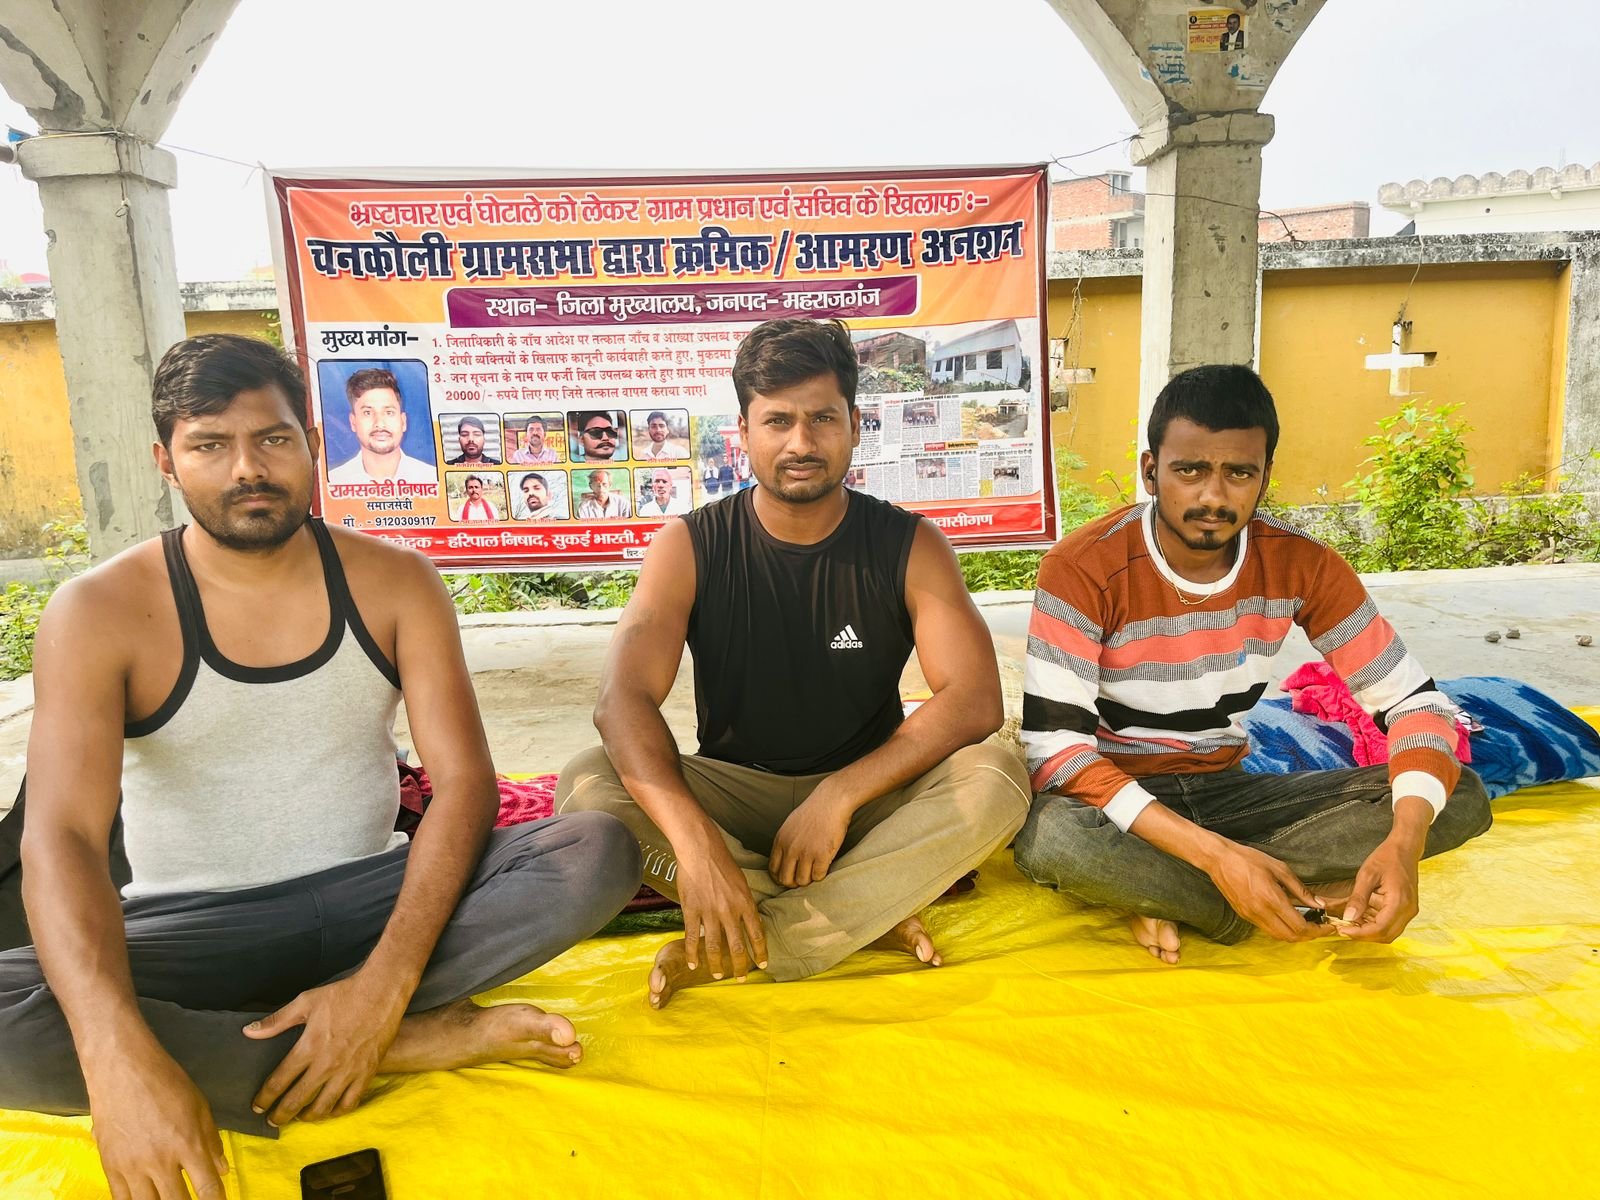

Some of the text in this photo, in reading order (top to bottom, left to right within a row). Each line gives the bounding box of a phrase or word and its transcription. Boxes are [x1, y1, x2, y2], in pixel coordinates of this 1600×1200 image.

[350, 200, 437, 226] भ्रष्टाचार
[441, 196, 472, 224] एवं
[478, 194, 541, 223] घोटाले
[547, 195, 577, 222] को
[582, 193, 640, 222] लेकर
[646, 198, 692, 222] ग्राम
[696, 197, 753, 221] प्रधान
[758, 187, 790, 219] एवं
[794, 186, 852, 219] सचिव
[855, 187, 879, 217] के
[883, 183, 963, 216] खिलाफ
[307, 232, 454, 280] चनकौली
[458, 239, 595, 282] ग्रामसभा
[600, 237, 666, 280] द्वारा
[921, 219, 1025, 266] अनशन
[485, 282, 880, 321] स्थान- जिला मुख्यालय, जनपद- महराजगंज
[321, 325, 419, 353] मुख्य मांग-
[446, 333, 504, 347] जिलाधिकारी
[507, 333, 517, 346] के
[545, 332, 574, 345] आदेश
[577, 335, 589, 345] पर
[592, 334, 625, 344] तत्काल
[653, 333, 660, 343] व
[664, 332, 694, 342] आख्या
[449, 352, 472, 366] दोषी
[475, 351, 516, 365] व्यक्तियों
[519, 351, 529, 364] के
[532, 350, 568, 364] खिलाफ
[571, 349, 603, 367] कानूनी
[651, 347, 672, 361] करते
[697, 349, 731, 364] मुकदमा
[450, 373, 467, 383] जन
[470, 373, 498, 387] सूचना
[502, 369, 511, 382] के
[515, 372, 534, 382] नाम
[537, 371, 548, 381] पर
[551, 368, 573, 381] फर्जी
[576, 368, 596, 381] बिल
[635, 366, 656, 379] करते
[660, 369, 673, 383] हुए
[676, 368, 695, 378] ग्राम
[522, 387, 541, 400] लिए
[544, 389, 559, 400] गए
[562, 386, 583, 398] जिसे
[586, 388, 619, 398] तत्काल
[622, 388, 648, 397] वापस
[651, 387, 680, 396] कराया
[330, 479, 438, 497] रामसनेही निषाद
[366, 498, 412, 510] समाजसेवी
[375, 516, 436, 526] 9120309117
[448, 532, 499, 548] हरिपाल
[502, 532, 549, 547] निषाद,
[552, 530, 590, 549] सुकई
[830, 640, 863, 649] adidas
